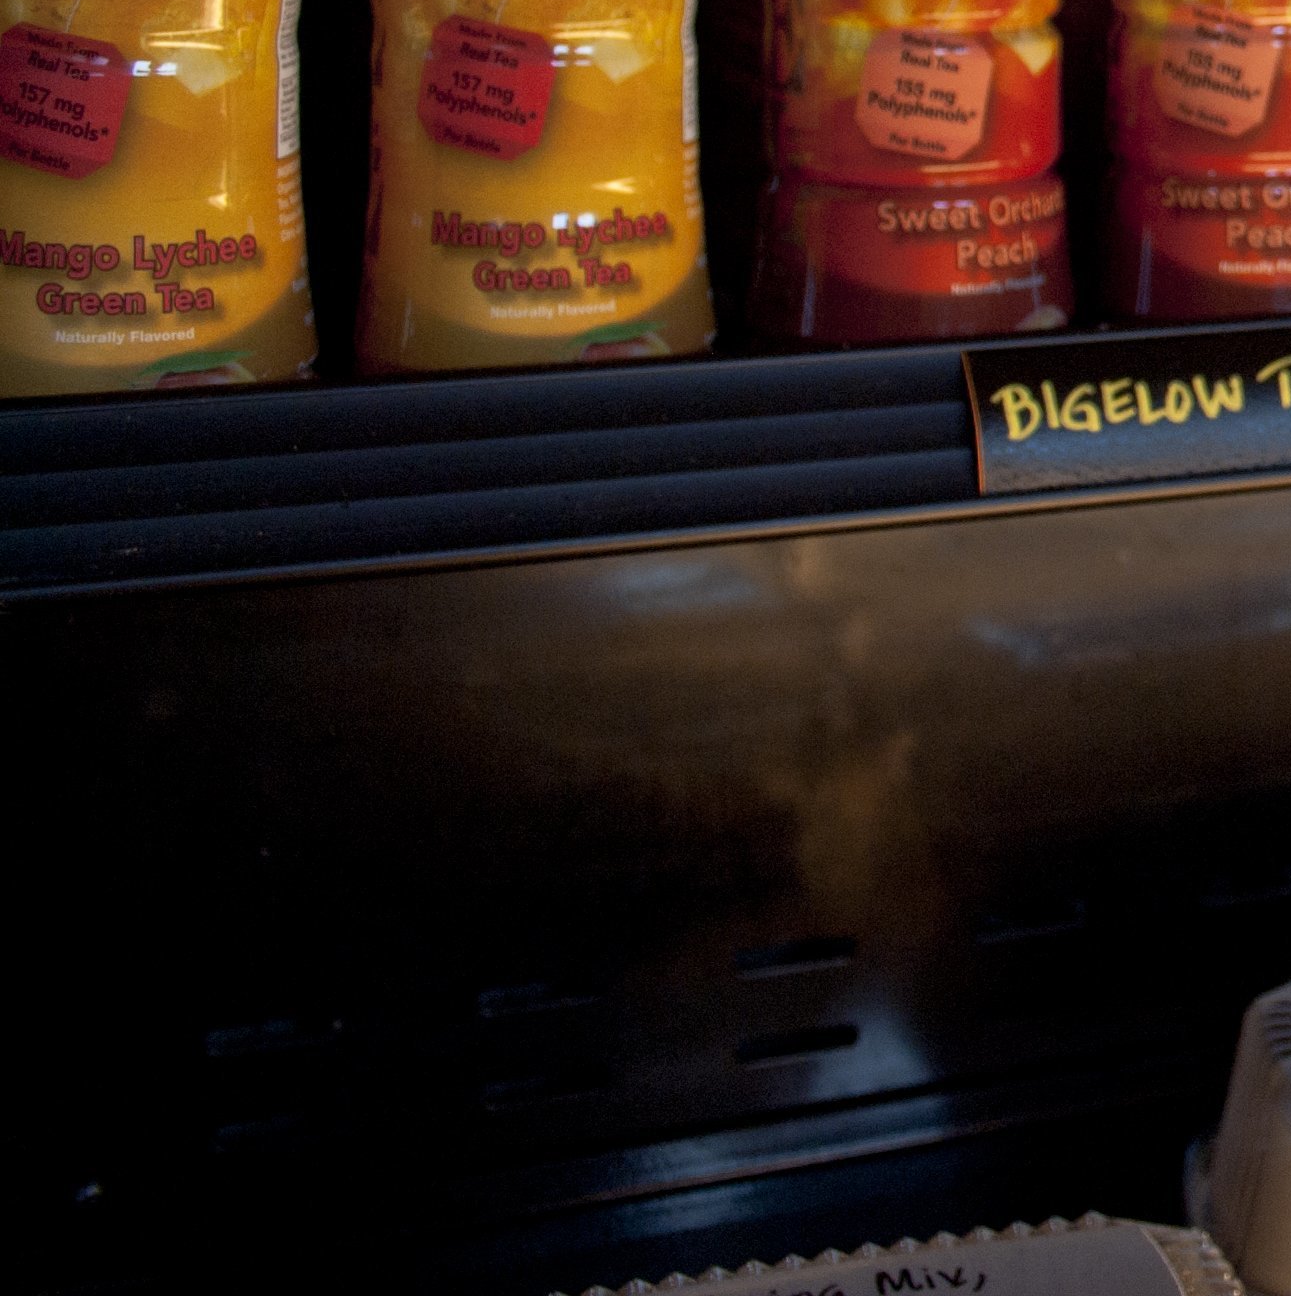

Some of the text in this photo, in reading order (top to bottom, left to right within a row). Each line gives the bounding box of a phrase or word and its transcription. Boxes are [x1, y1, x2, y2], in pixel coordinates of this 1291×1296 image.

[27, 50, 91, 82] Real Tea
[19, 81, 86, 120] 157 mg
[452, 70, 514, 105] 157 mg
[929, 89, 956, 106] mg
[0, 97, 110, 142] olyphenols
[1160, 177, 1251, 212] Sweet
[432, 208, 669, 255] Mango Lychee
[877, 200, 982, 236] Sweet
[0, 230, 257, 280] Mango Lychee
[955, 230, 1038, 271] Peach
[473, 259, 633, 293] Green Tea
[36, 283, 215, 316] Green Tea
[55, 327, 196, 346] Naturally Flavored
[991, 373, 1245, 442] BIGELOW
